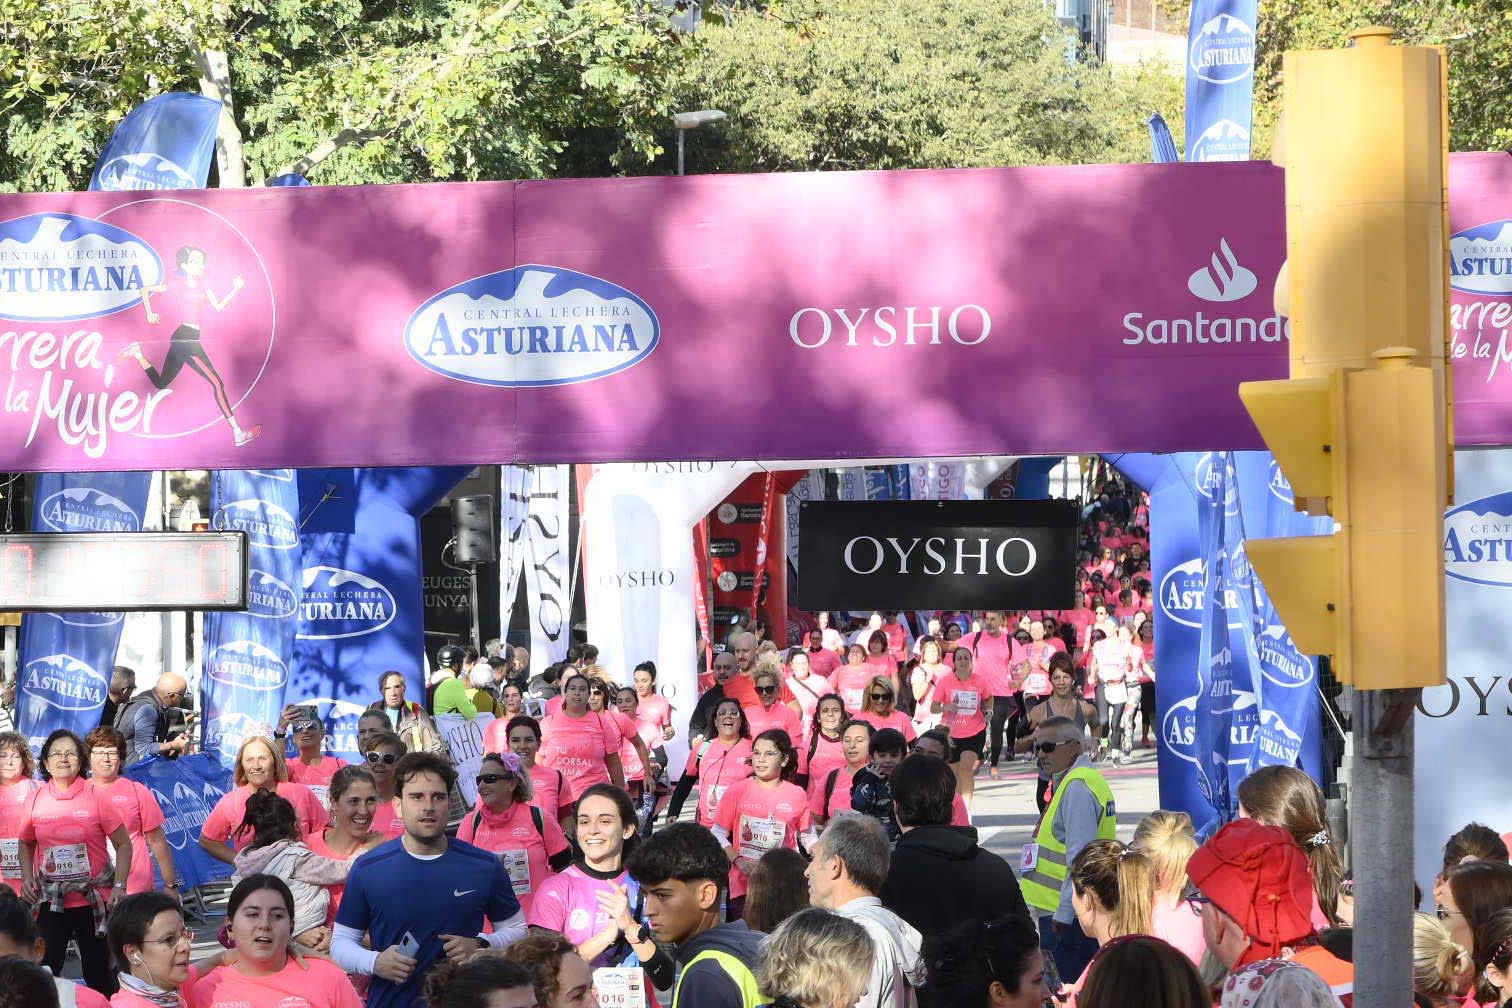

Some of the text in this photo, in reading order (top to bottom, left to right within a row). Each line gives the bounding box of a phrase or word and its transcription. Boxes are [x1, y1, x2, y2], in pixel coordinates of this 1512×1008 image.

[67, 249, 138, 260] LECHERA
[463, 305, 632, 320] CENTRAL LECHERA
[790, 303, 992, 349] OYSHO
[425, 311, 640, 358] ASTURIANA
[1123, 311, 1289, 346] Santand
[1473, 331, 1491, 358] la
[6, 374, 30, 413] la
[25, 365, 174, 459] Mujer
[844, 535, 1037, 577] OYSHO
[598, 571, 675, 588] OYSHO
[556, 757, 593, 767] DORSAL
[602, 994, 625, 1004] 016
